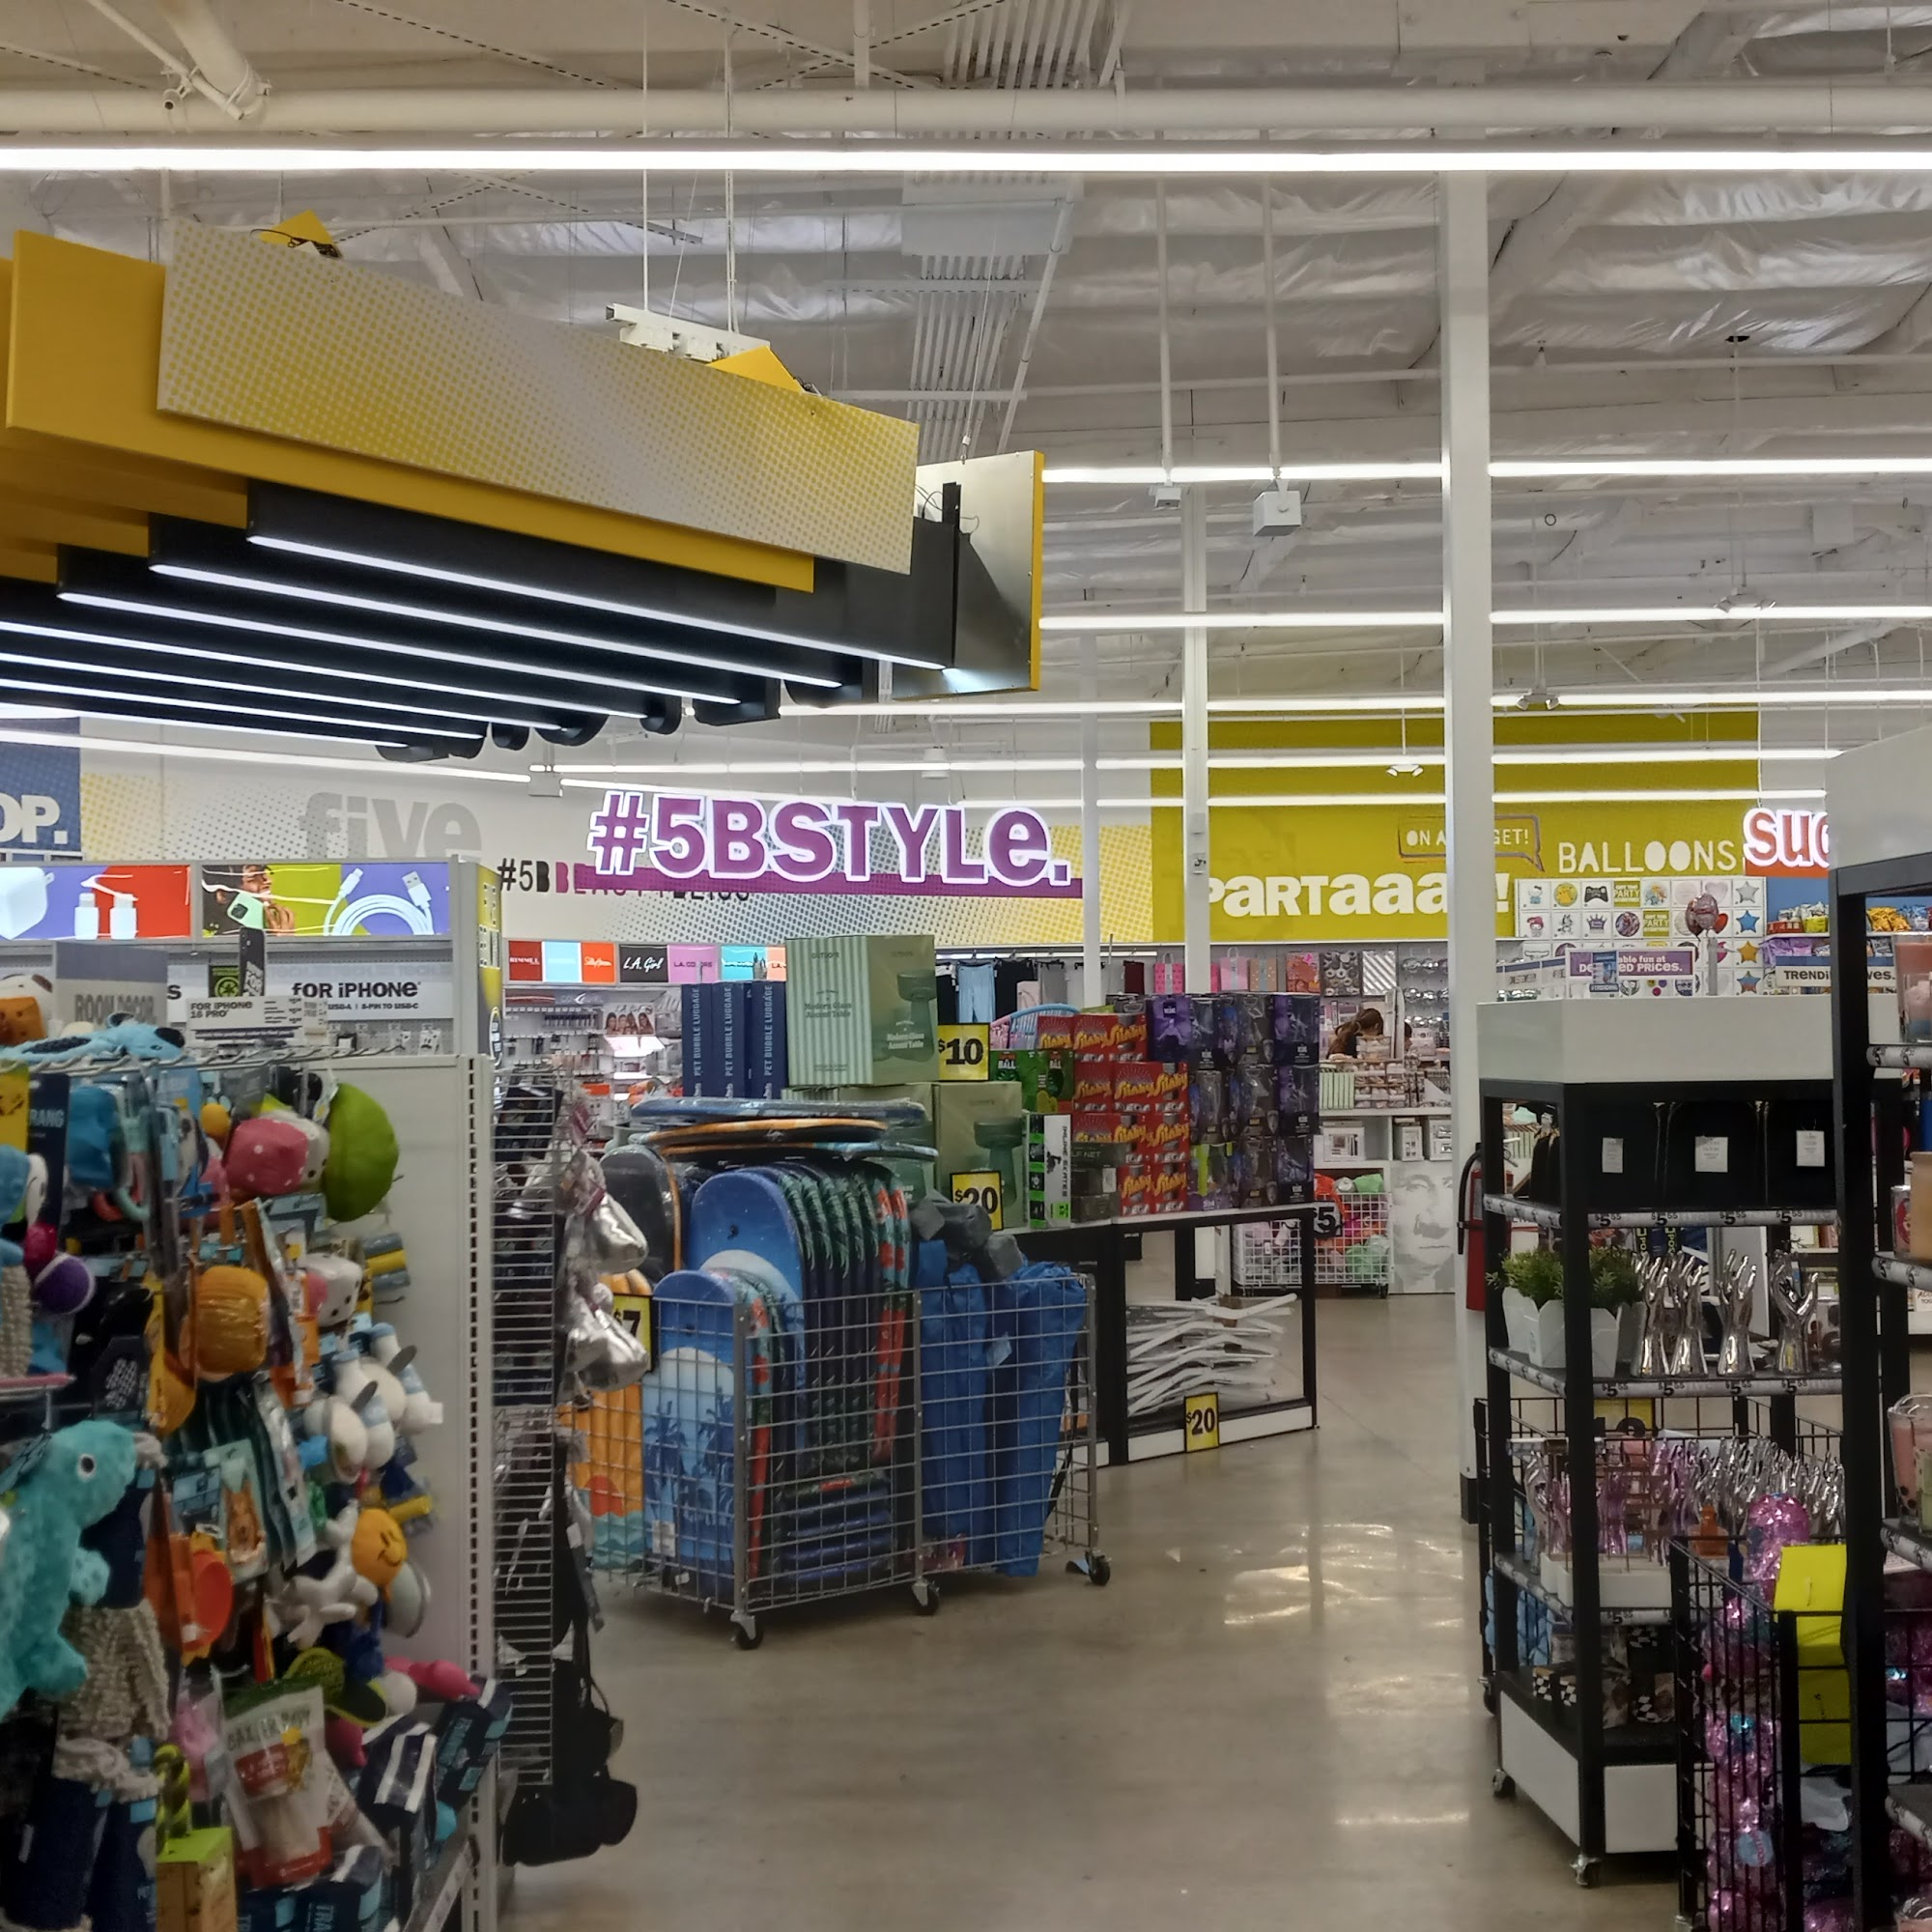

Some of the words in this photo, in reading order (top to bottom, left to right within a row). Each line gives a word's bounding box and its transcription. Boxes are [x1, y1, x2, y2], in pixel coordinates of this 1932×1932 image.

[298, 792, 482, 858] five
[1406, 829, 1431, 846] ON
[1558, 840, 1738, 874] BALLOONS
[623, 956, 642, 970] L.A.
[643, 956, 665, 973] Girl
[1638, 954, 1655, 963] fun
[292, 982, 333, 998] fOR
[338, 981, 419, 998] iPHONe
[938, 1038, 984, 1065] $10
[724, 1061, 733, 1077] PET
[764, 1060, 773, 1076] PET
[954, 1187, 999, 1214] $20
[1186, 1406, 1216, 1435] $20
